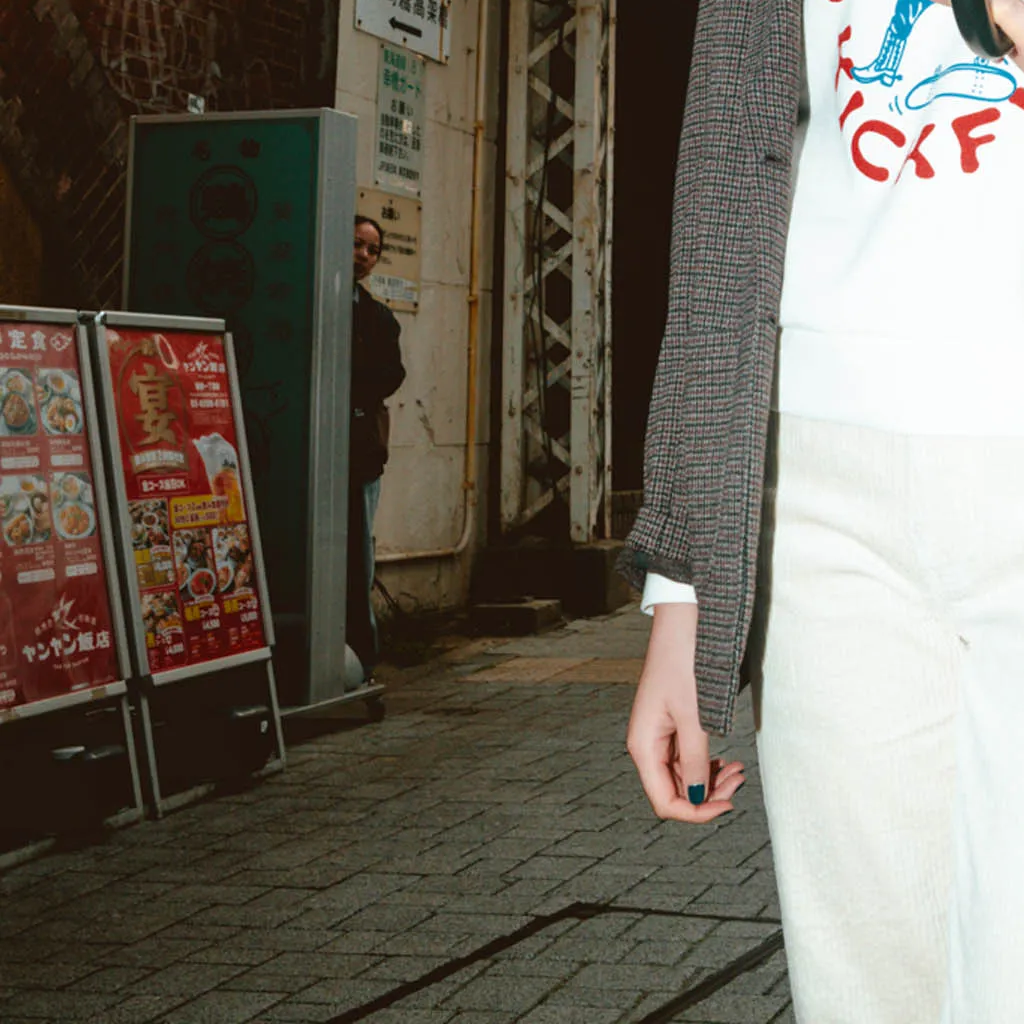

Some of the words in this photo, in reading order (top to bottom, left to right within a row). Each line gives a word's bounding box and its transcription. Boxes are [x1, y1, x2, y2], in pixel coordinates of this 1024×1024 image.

[0, 329, 47, 351] 定食
[22, 629, 110, 664] ヤンヤン飯店
